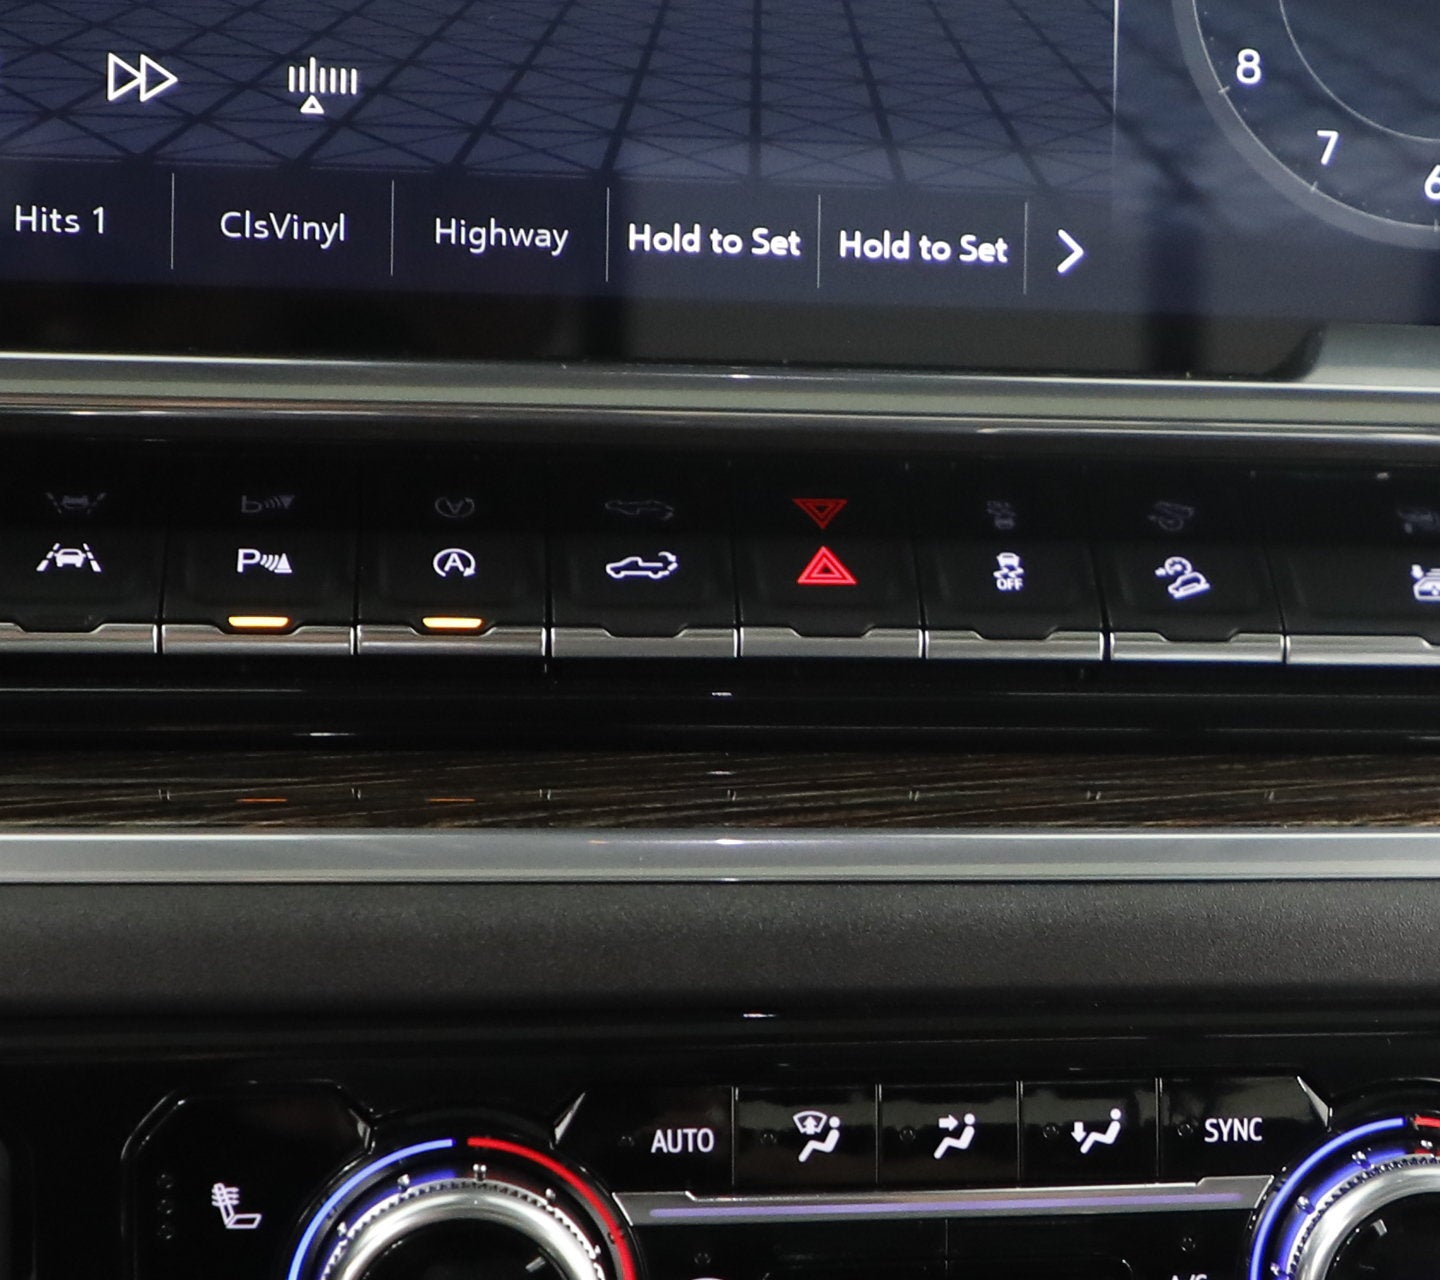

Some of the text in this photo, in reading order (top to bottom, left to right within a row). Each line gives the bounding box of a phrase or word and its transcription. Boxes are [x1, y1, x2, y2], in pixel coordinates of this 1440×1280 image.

[1237, 49, 1261, 86] 8
[1317, 130, 1338, 165] 7
[16, 205, 107, 234] Hits 1
[220, 210, 346, 250] ClsVinyl
[436, 218, 568, 256] Highway
[629, 223, 801, 257] Hold to Set
[840, 230, 1008, 264] Hold to Set
[995, 576, 1024, 591] OFF
[651, 1128, 714, 1153] AUTO
[1205, 1117, 1262, 1142] SYNC
